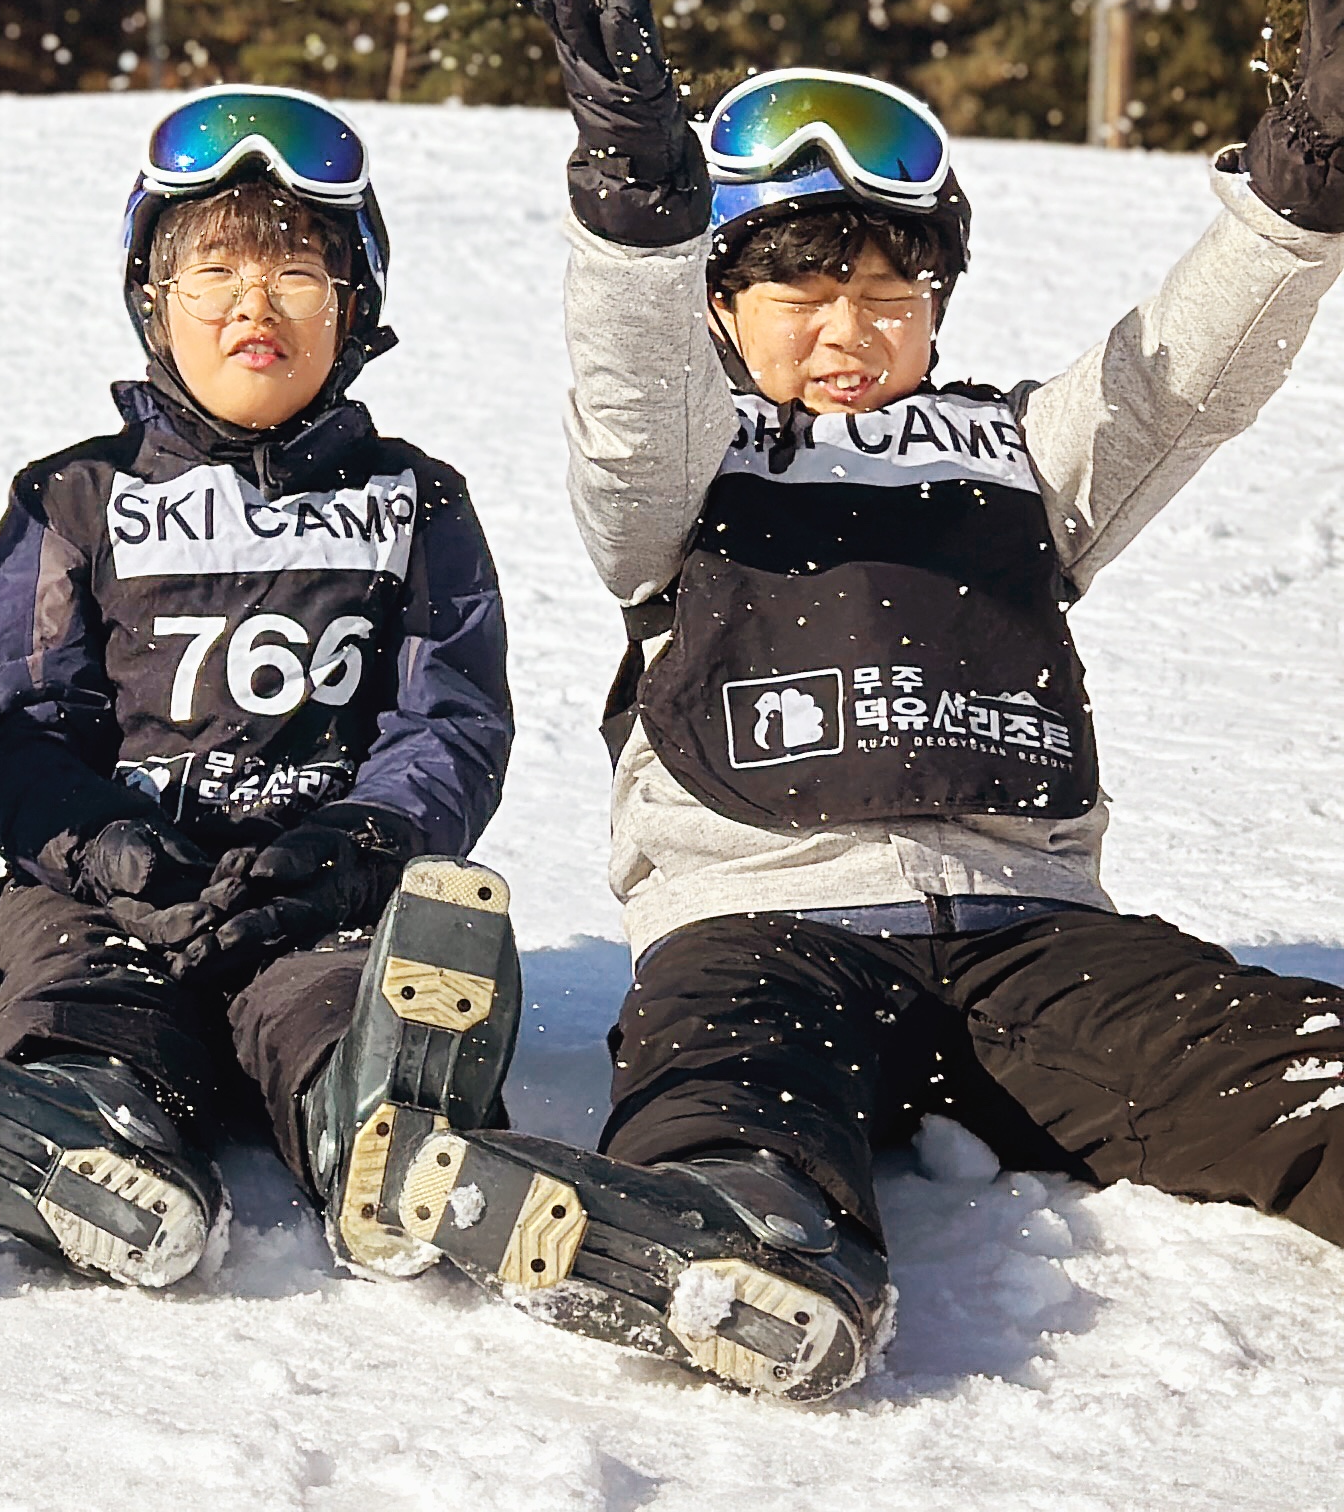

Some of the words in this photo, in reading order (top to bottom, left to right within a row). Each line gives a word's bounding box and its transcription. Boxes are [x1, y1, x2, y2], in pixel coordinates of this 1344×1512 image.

[845, 404, 1029, 463] CAMP
[113, 487, 215, 545] SKI
[244, 492, 415, 544] CAMP
[153, 613, 374, 723] 766
[854, 689, 1073, 758] 덕유산리조트
